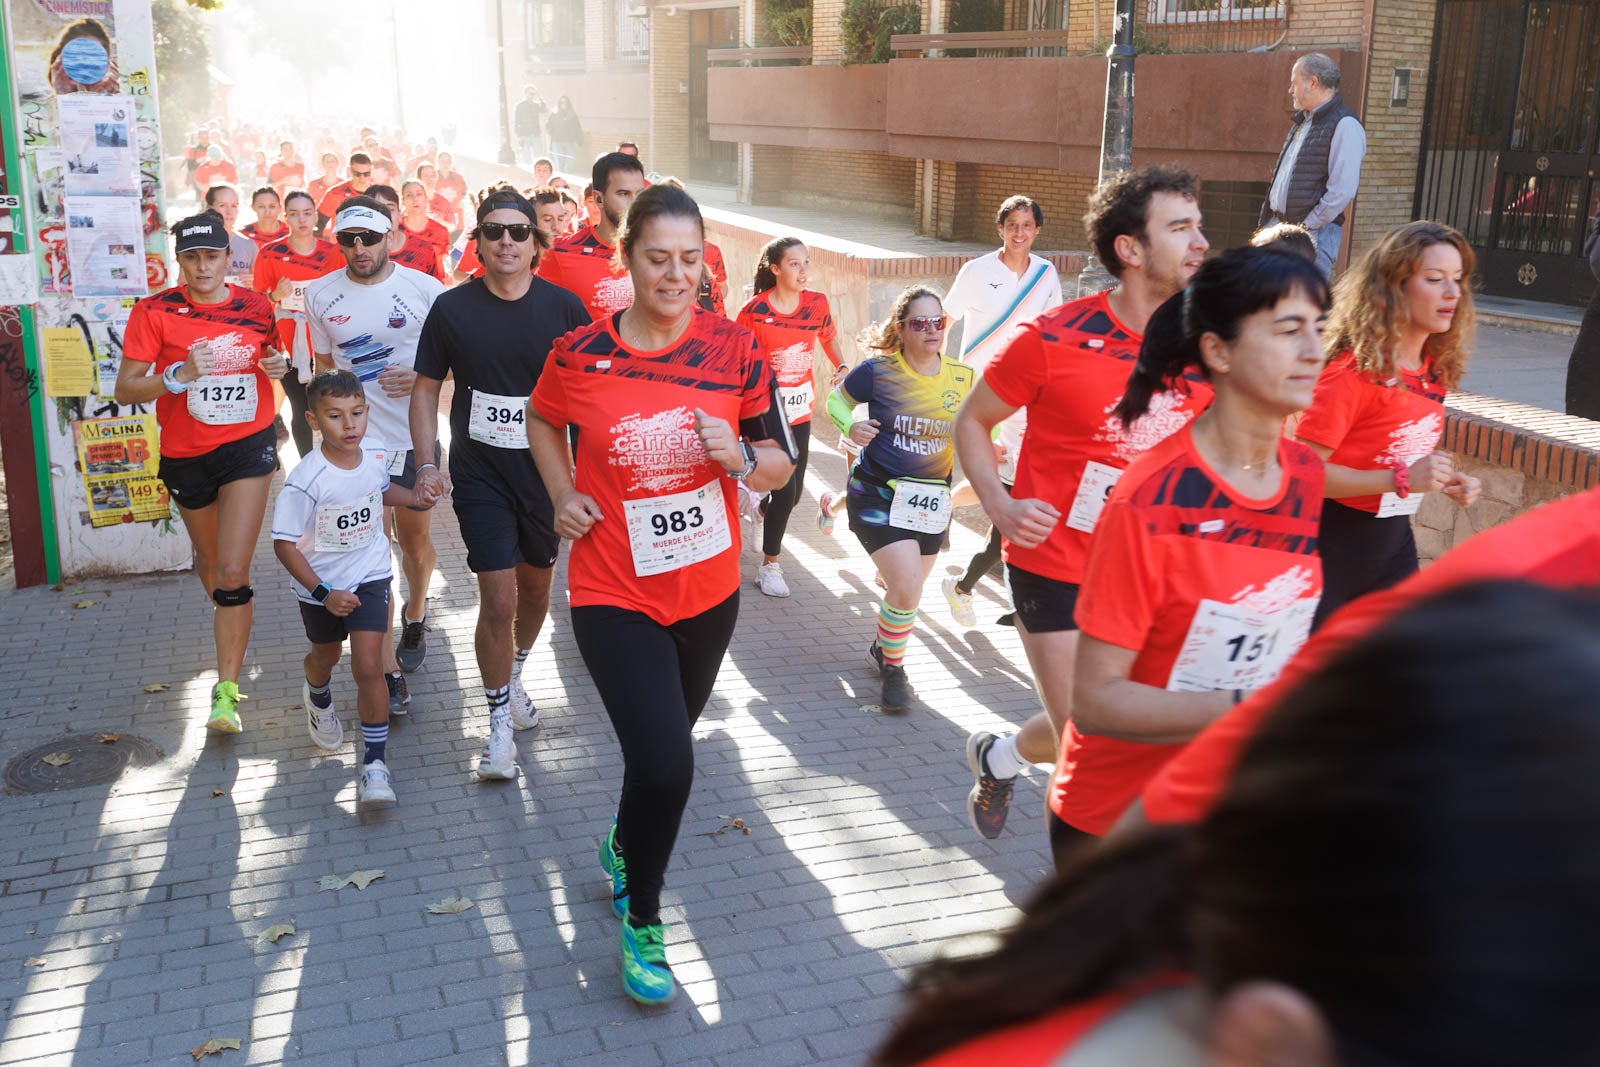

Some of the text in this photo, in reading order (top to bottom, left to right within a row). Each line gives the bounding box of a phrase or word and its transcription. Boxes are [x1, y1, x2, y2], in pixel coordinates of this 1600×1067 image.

[200, 386, 246, 401] 1372
[487, 406, 524, 425] 394
[893, 415, 951, 436] ATLETISM
[130, 484, 152, 498] 149
[908, 494, 939, 512] 446
[337, 507, 371, 530] 639
[651, 506, 704, 537] 983
[652, 526, 714, 549] MUERDE EL POLVO
[1226, 628, 1282, 662] 151
